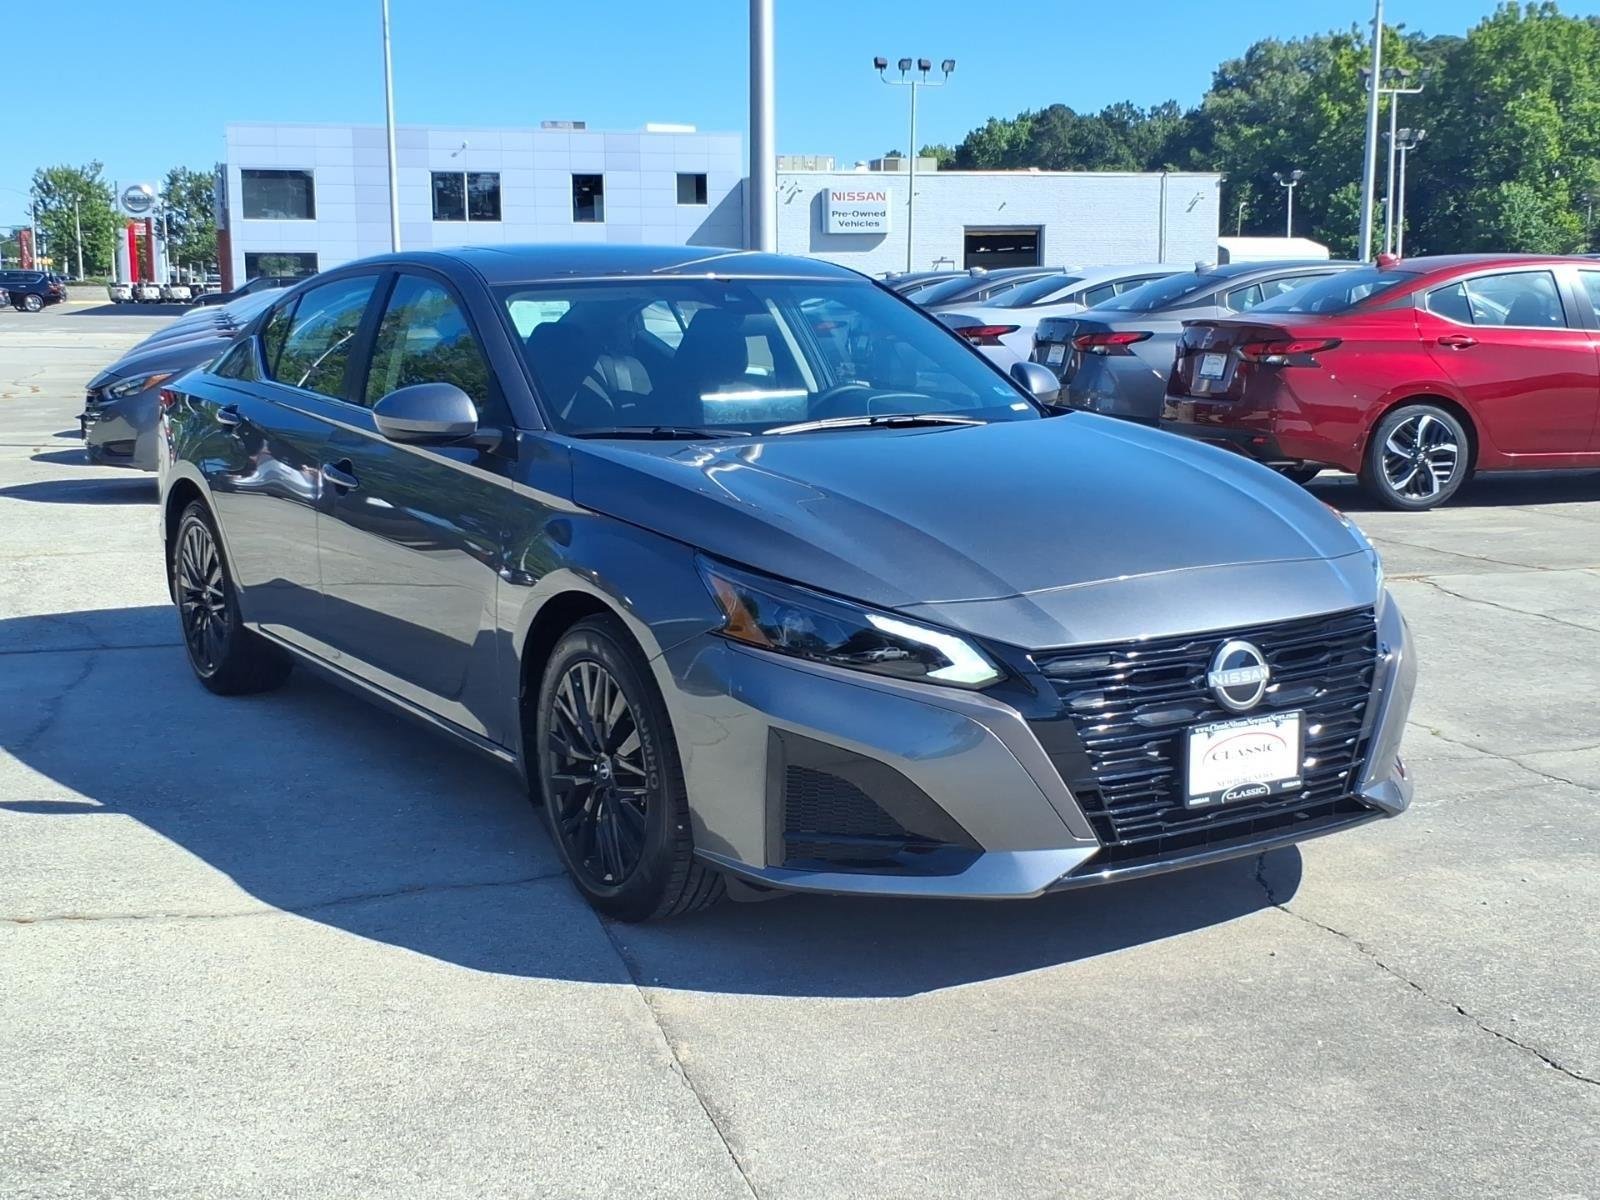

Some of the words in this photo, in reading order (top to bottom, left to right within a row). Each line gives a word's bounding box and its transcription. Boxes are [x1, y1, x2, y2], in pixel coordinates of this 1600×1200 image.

[832, 191, 886, 201] NISSAN
[832, 210, 886, 218] Pre-Owned
[1211, 666, 1269, 686] NISSAN
[1211, 743, 1274, 761] CLASSIC
[1225, 786, 1266, 800] CLASSIC
